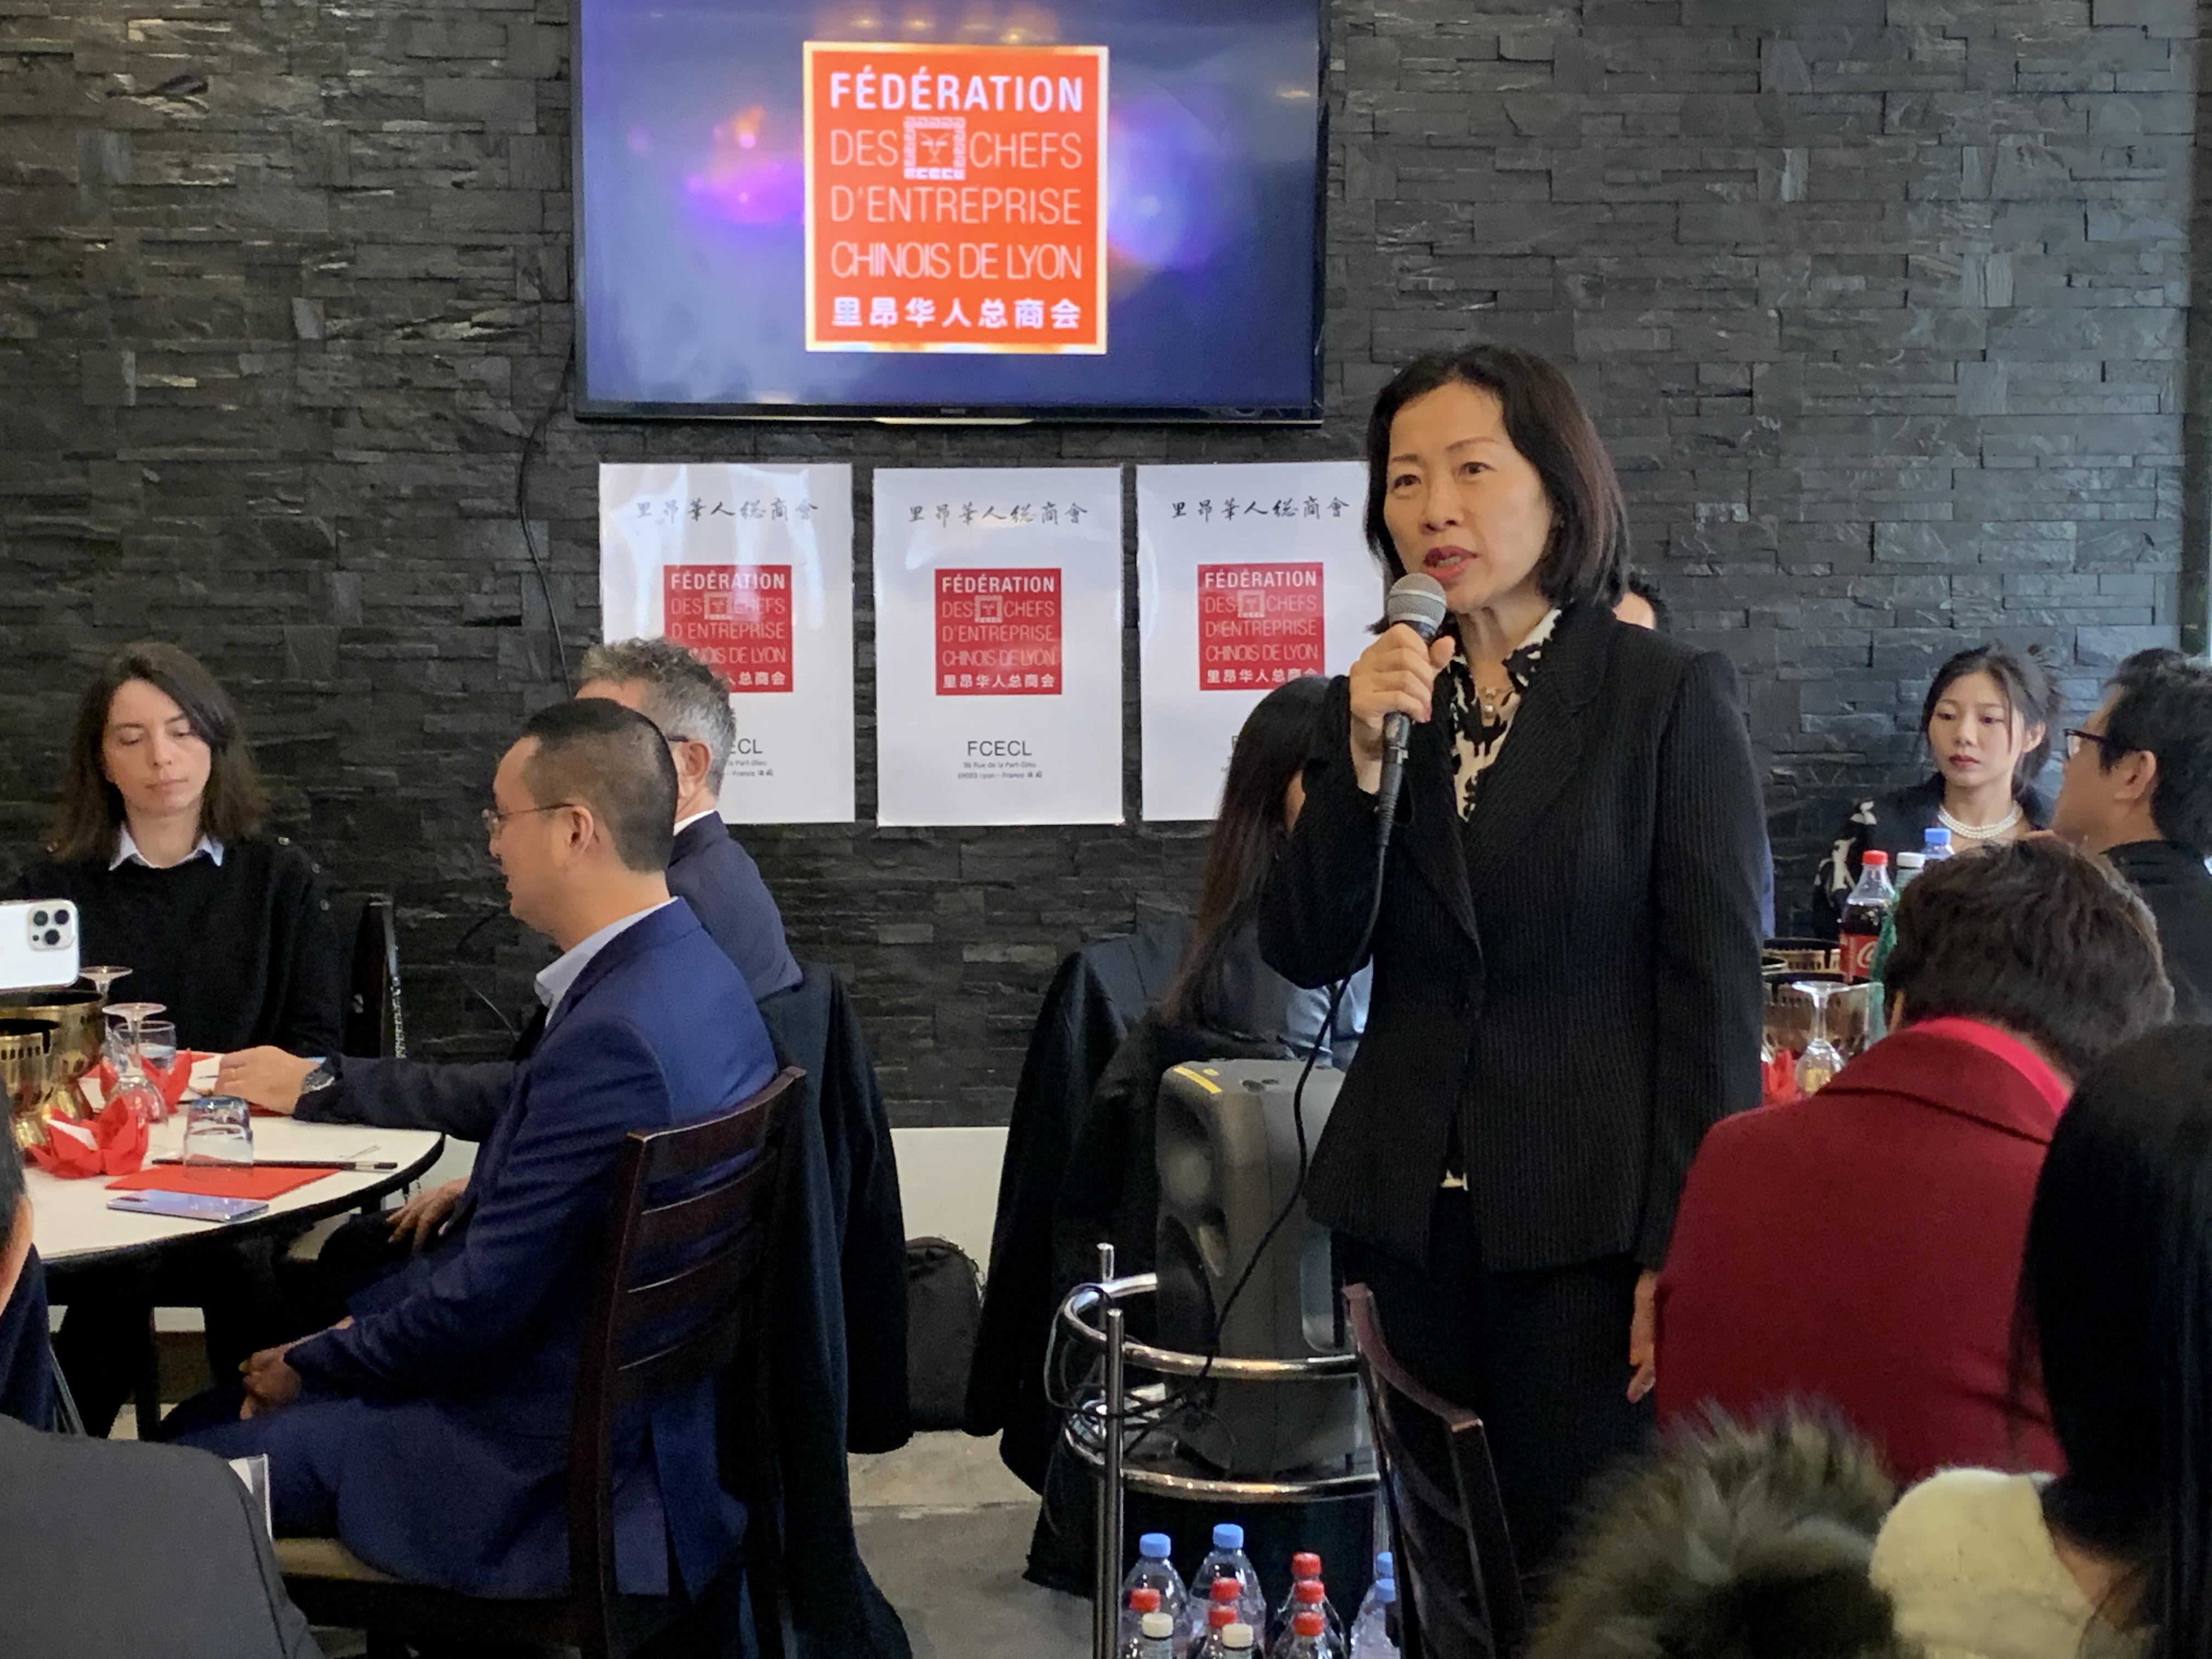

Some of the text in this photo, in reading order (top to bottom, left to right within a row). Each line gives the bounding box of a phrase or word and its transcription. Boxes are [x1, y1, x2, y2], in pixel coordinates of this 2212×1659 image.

[830, 65, 1082, 112] FÉDÉRATION
[831, 129, 1082, 169] DES CHEFS
[831, 186, 1082, 225] D'ENTREPRISE
[831, 241, 1082, 280] CHINOIS DE LYON
[832, 296, 1081, 329] 里昂华人总商会
[671, 569, 786, 590] FÉDÉRATION
[942, 573, 1055, 594] FÉDÉRATION
[1205, 568, 1317, 589] FÉDÉRATION
[671, 597, 703, 615] DES
[942, 600, 1055, 618] DES CHEFS
[1205, 594, 1317, 613] DES CHEFS
[942, 624, 1056, 642] D'ENTREPRISE
[1205, 618, 1317, 637] D'ENTREPRISE
[729, 647, 748, 664] DE
[751, 646, 786, 664] LYON
[942, 649, 1056, 667] CHINOIS DE LYON
[1205, 643, 1318, 662] CHINOIS DE LYON
[943, 673, 1055, 689] 里昂华人总商会
[967, 740, 1032, 757] FCECL
